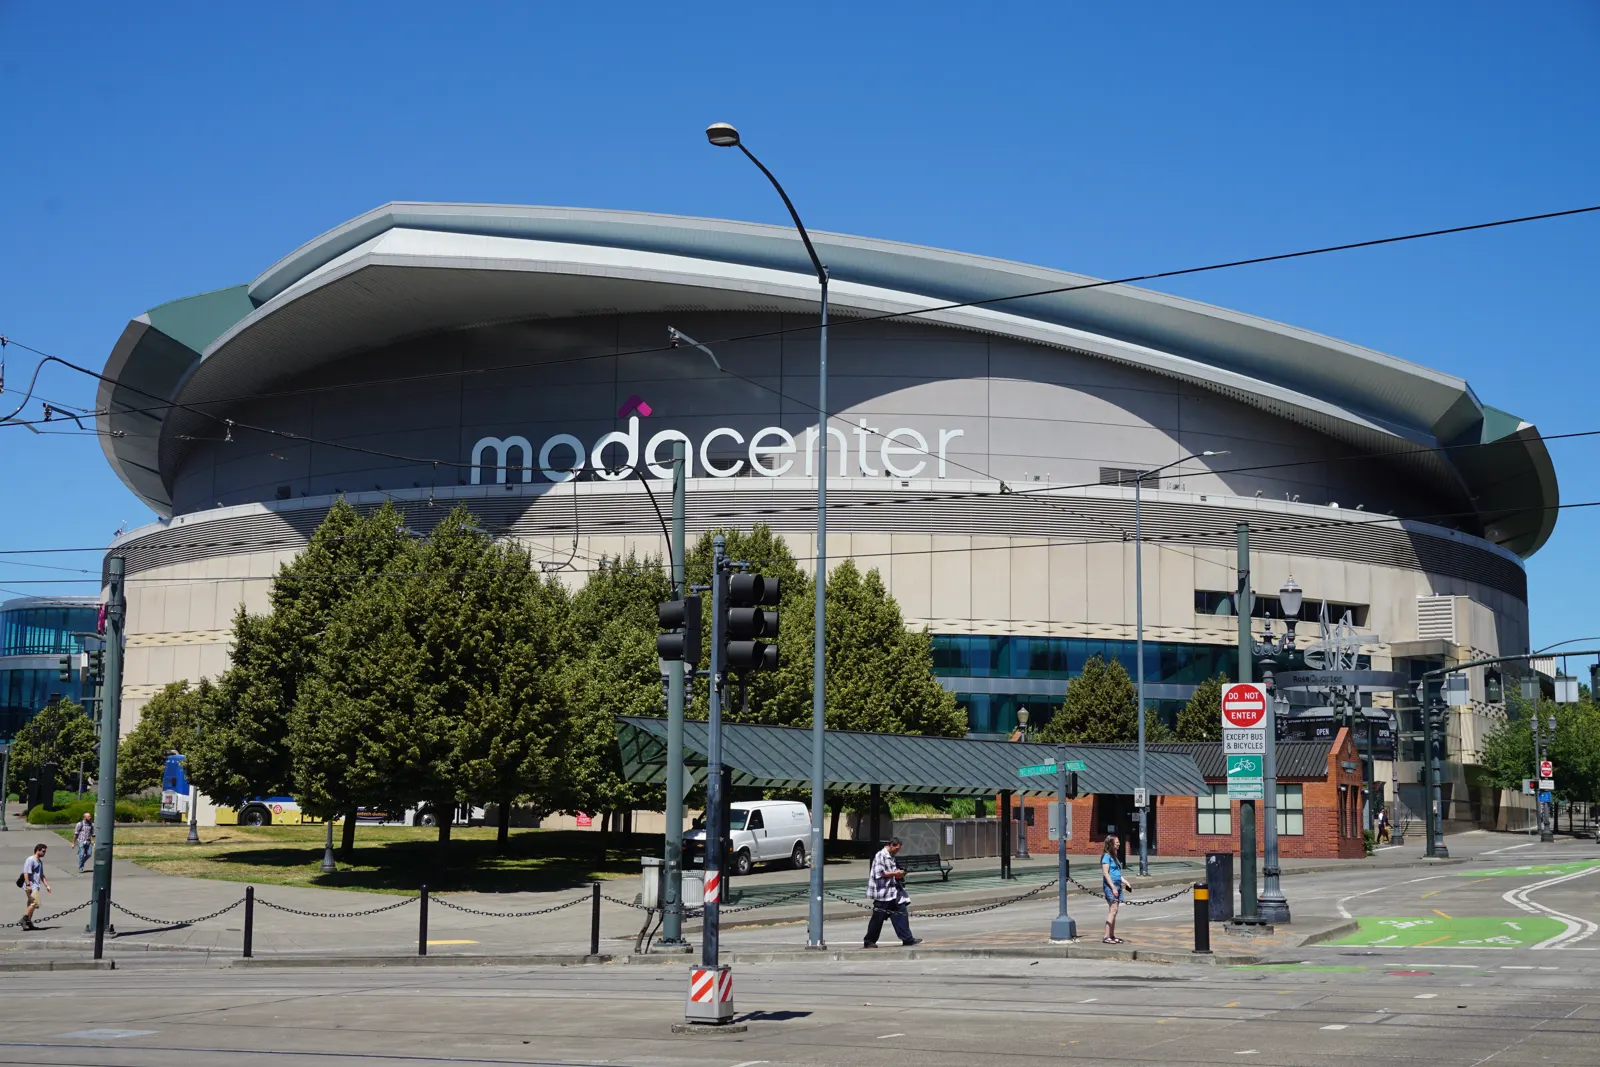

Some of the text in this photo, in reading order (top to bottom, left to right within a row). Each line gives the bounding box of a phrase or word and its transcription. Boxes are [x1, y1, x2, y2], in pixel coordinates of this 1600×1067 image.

[470, 415, 965, 484] modacenter
[1228, 692, 1259, 700] DO NOT
[1231, 711, 1257, 719] ENTER
[1316, 728, 1330, 736] OPEN
[1378, 729, 1390, 737] OPEN
[1226, 733, 1263, 741] EXCEPT BUS
[1226, 742, 1263, 750] & BICYCLES
